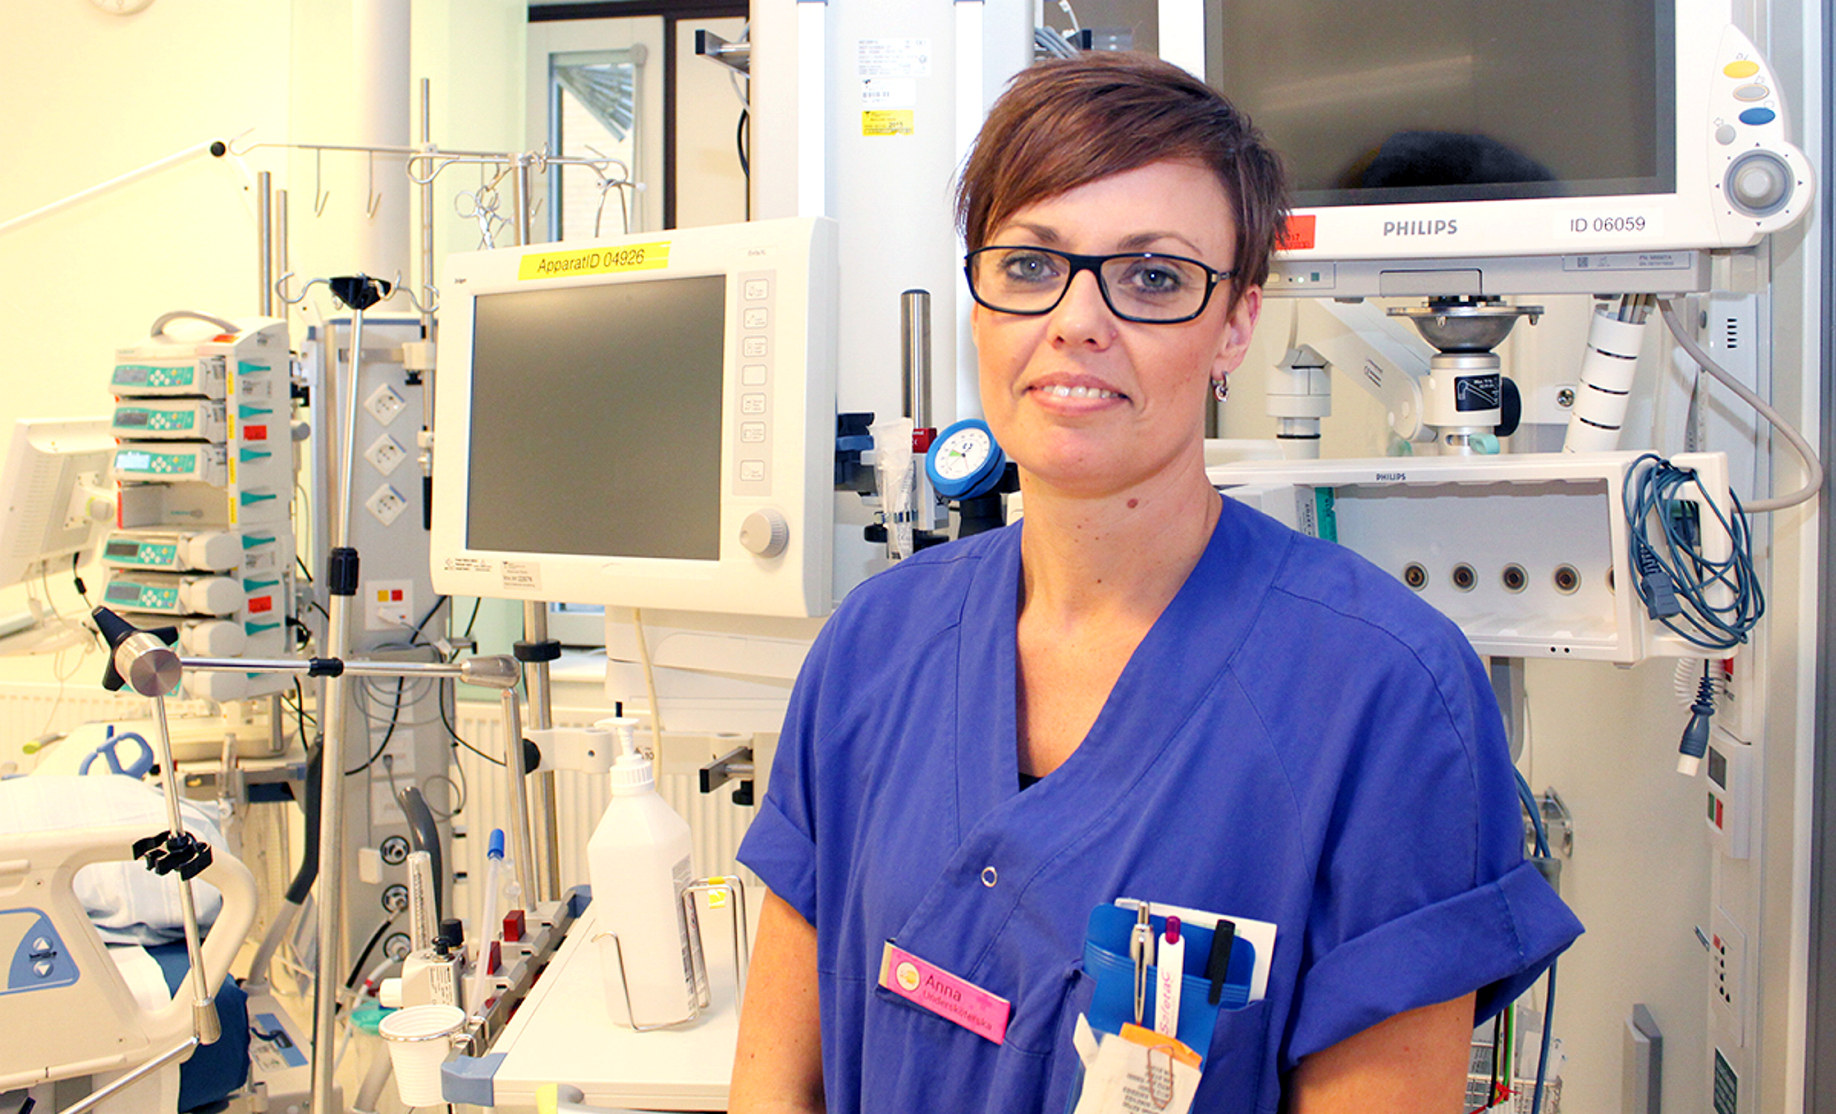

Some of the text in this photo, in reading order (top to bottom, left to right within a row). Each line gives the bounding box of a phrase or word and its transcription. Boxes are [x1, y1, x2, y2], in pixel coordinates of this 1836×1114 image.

[1383, 219, 1458, 236] PHILIPS
[1570, 216, 1646, 232] ID 06059
[537, 248, 645, 275] ApparatID 04926
[1376, 473, 1406, 481] PHILIPS
[925, 974, 962, 1002] Anna
